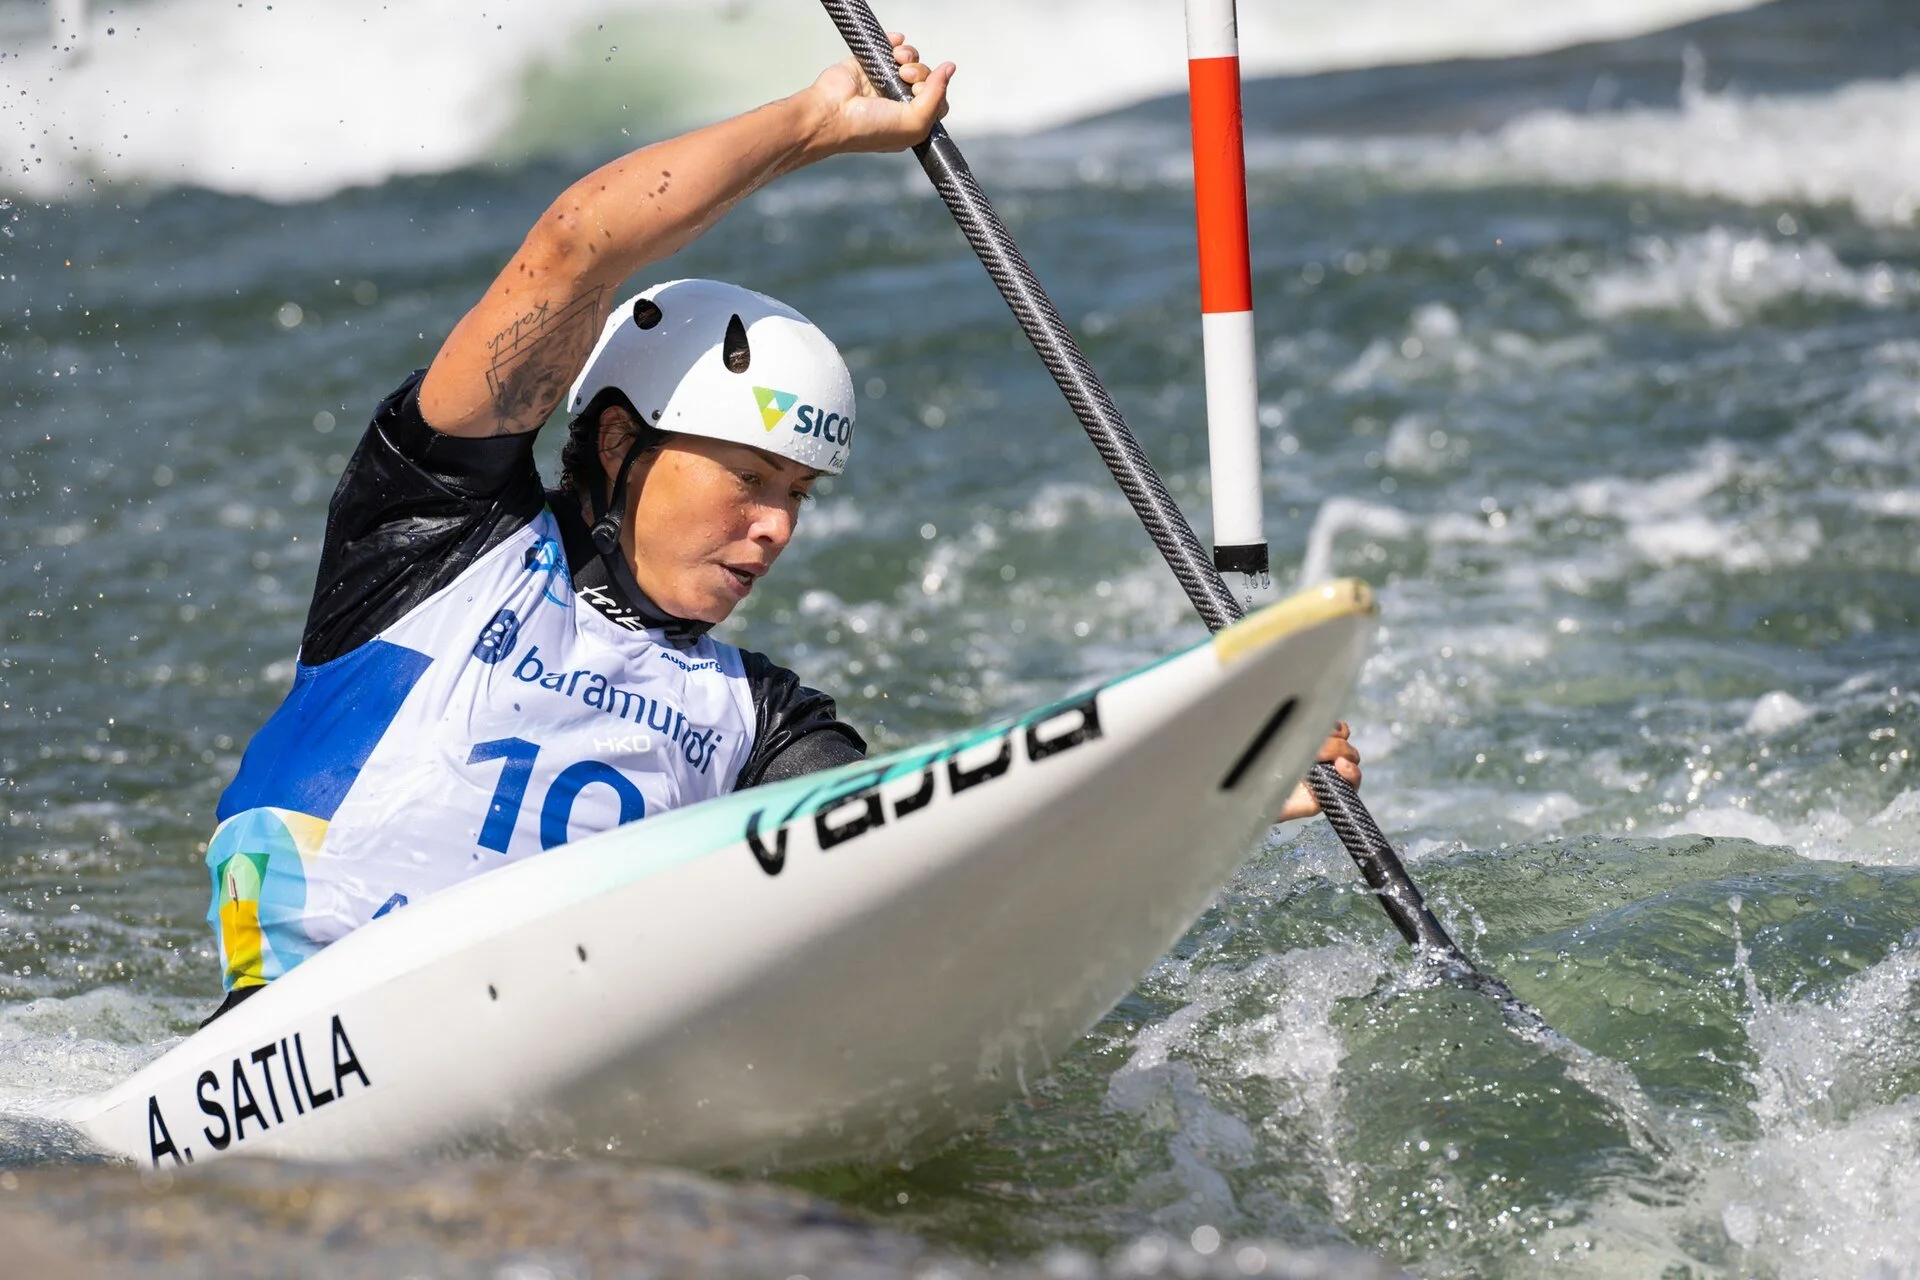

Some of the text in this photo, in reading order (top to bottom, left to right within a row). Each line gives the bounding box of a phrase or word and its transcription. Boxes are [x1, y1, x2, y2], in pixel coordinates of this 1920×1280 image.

[793, 404, 855, 450] SICO
[512, 645, 723, 775] baramundi
[660, 652, 723, 673] Augsburg
[466, 736, 645, 855] 10
[149, 1014, 371, 1172] A. SATILA
